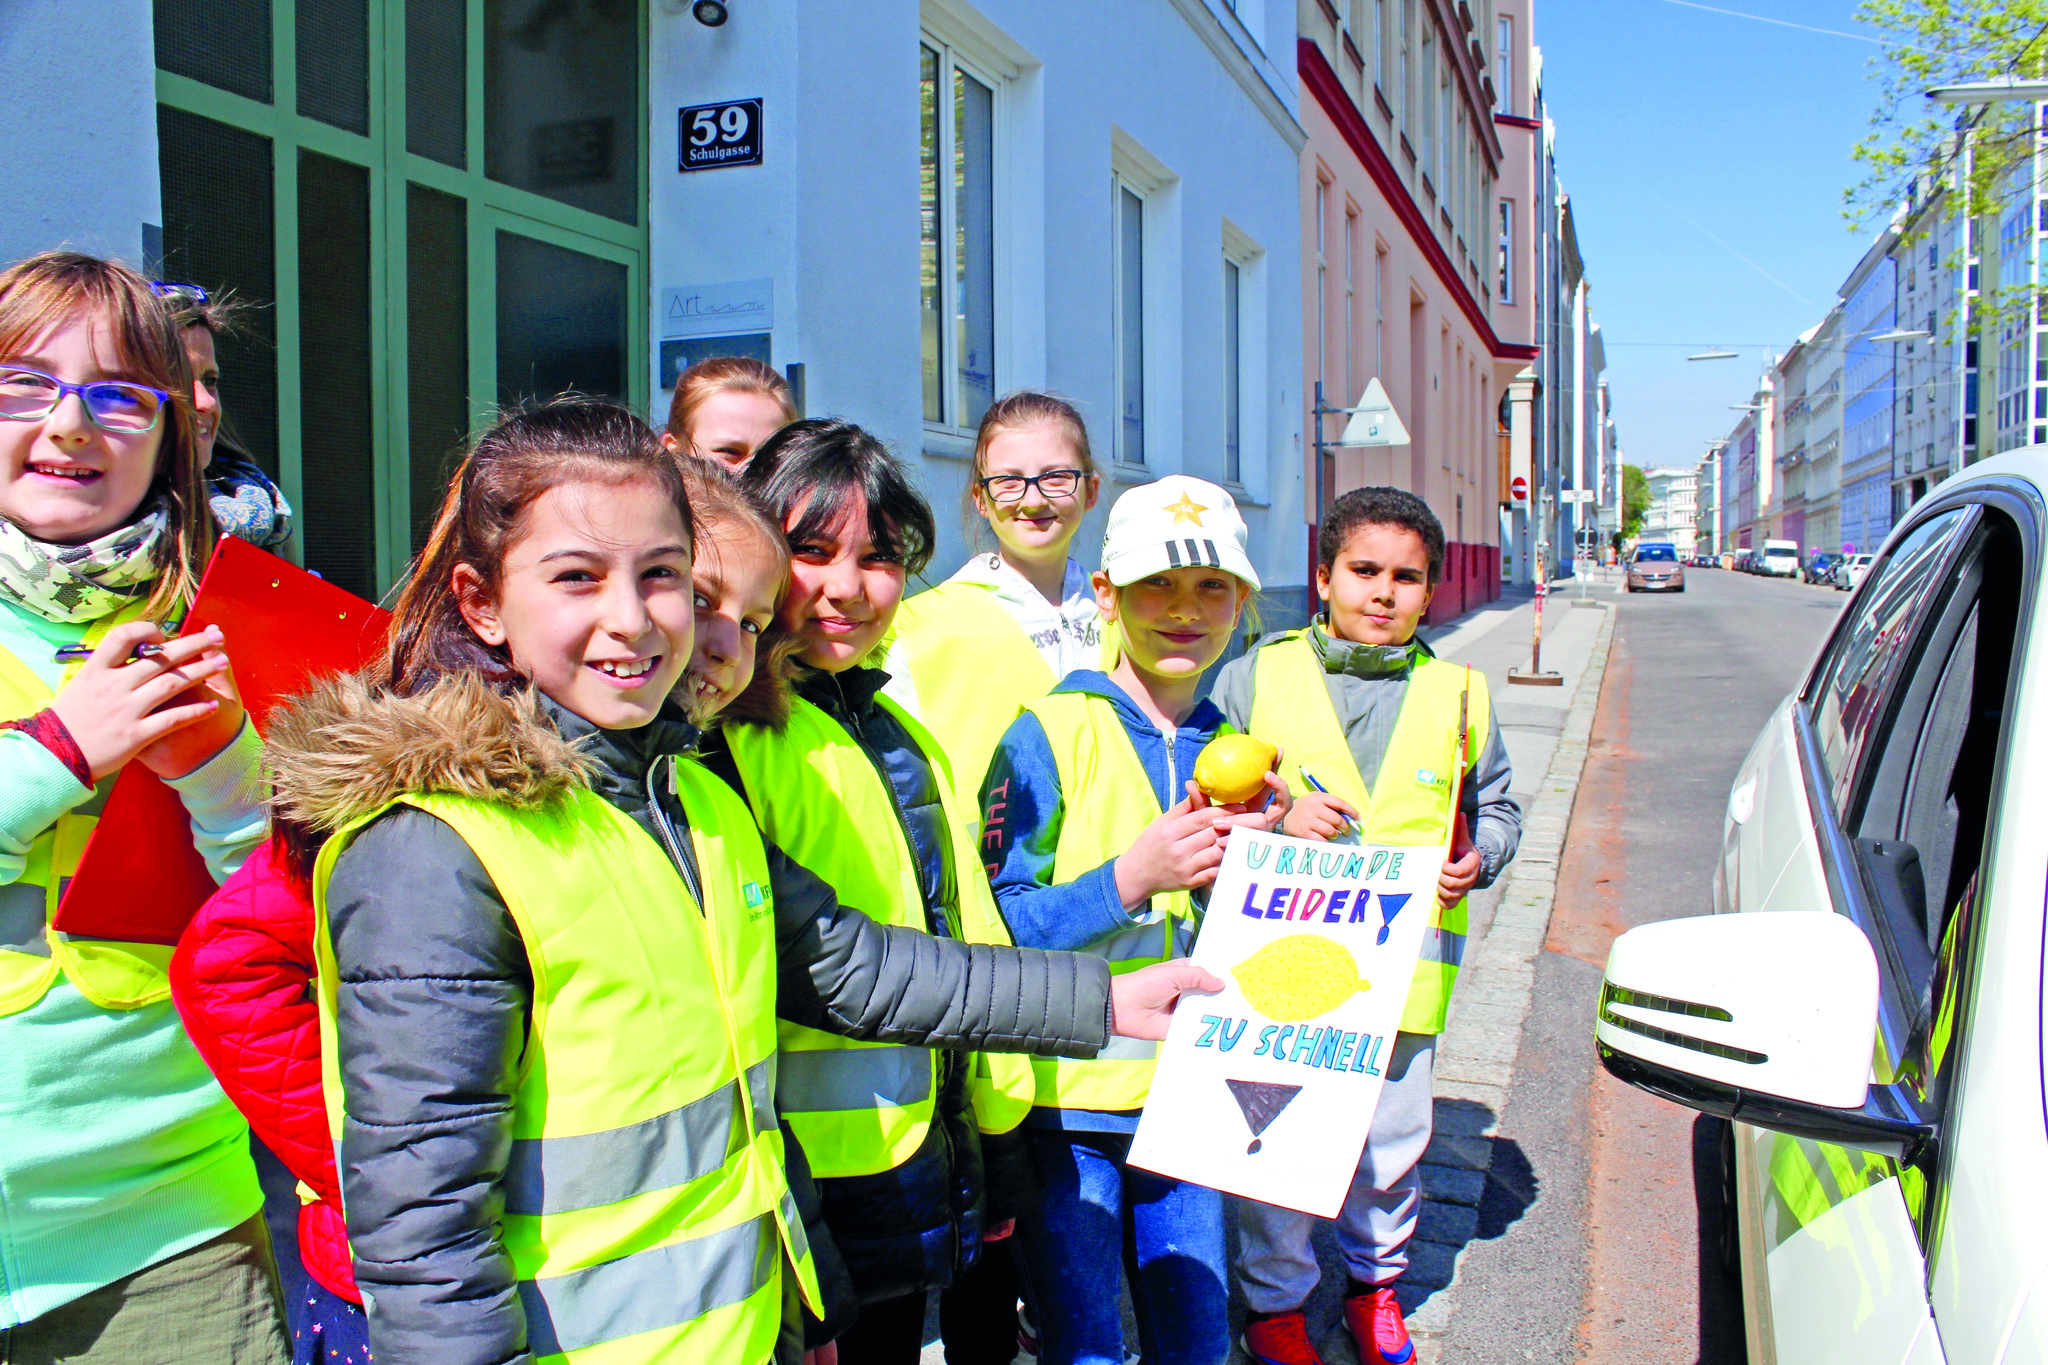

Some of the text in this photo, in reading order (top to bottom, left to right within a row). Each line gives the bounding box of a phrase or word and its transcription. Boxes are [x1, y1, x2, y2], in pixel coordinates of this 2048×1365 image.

[690, 106, 749, 147] 59
[690, 145, 751, 161] Schulgasse
[1180, 504, 1194, 513] 14
[1247, 841, 1405, 881] URKUNDE
[1194, 1014, 1384, 1077] ZU SCHNELL
